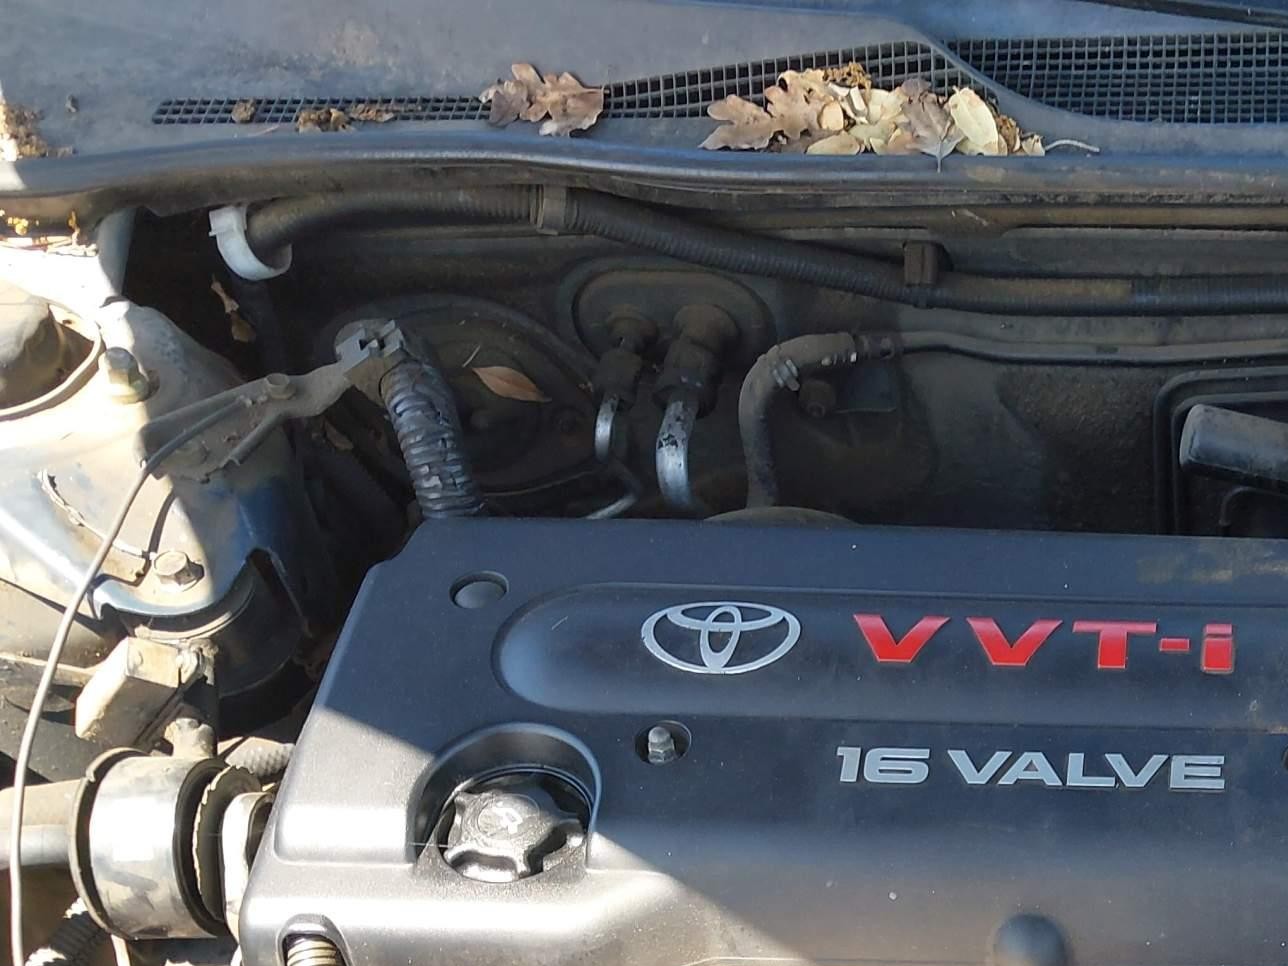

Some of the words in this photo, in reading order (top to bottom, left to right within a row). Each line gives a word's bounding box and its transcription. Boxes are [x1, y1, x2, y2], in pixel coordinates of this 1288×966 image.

[852, 614, 1235, 674] VVT-i
[835, 747, 931, 784] 16
[947, 749, 1226, 790] VALVE
